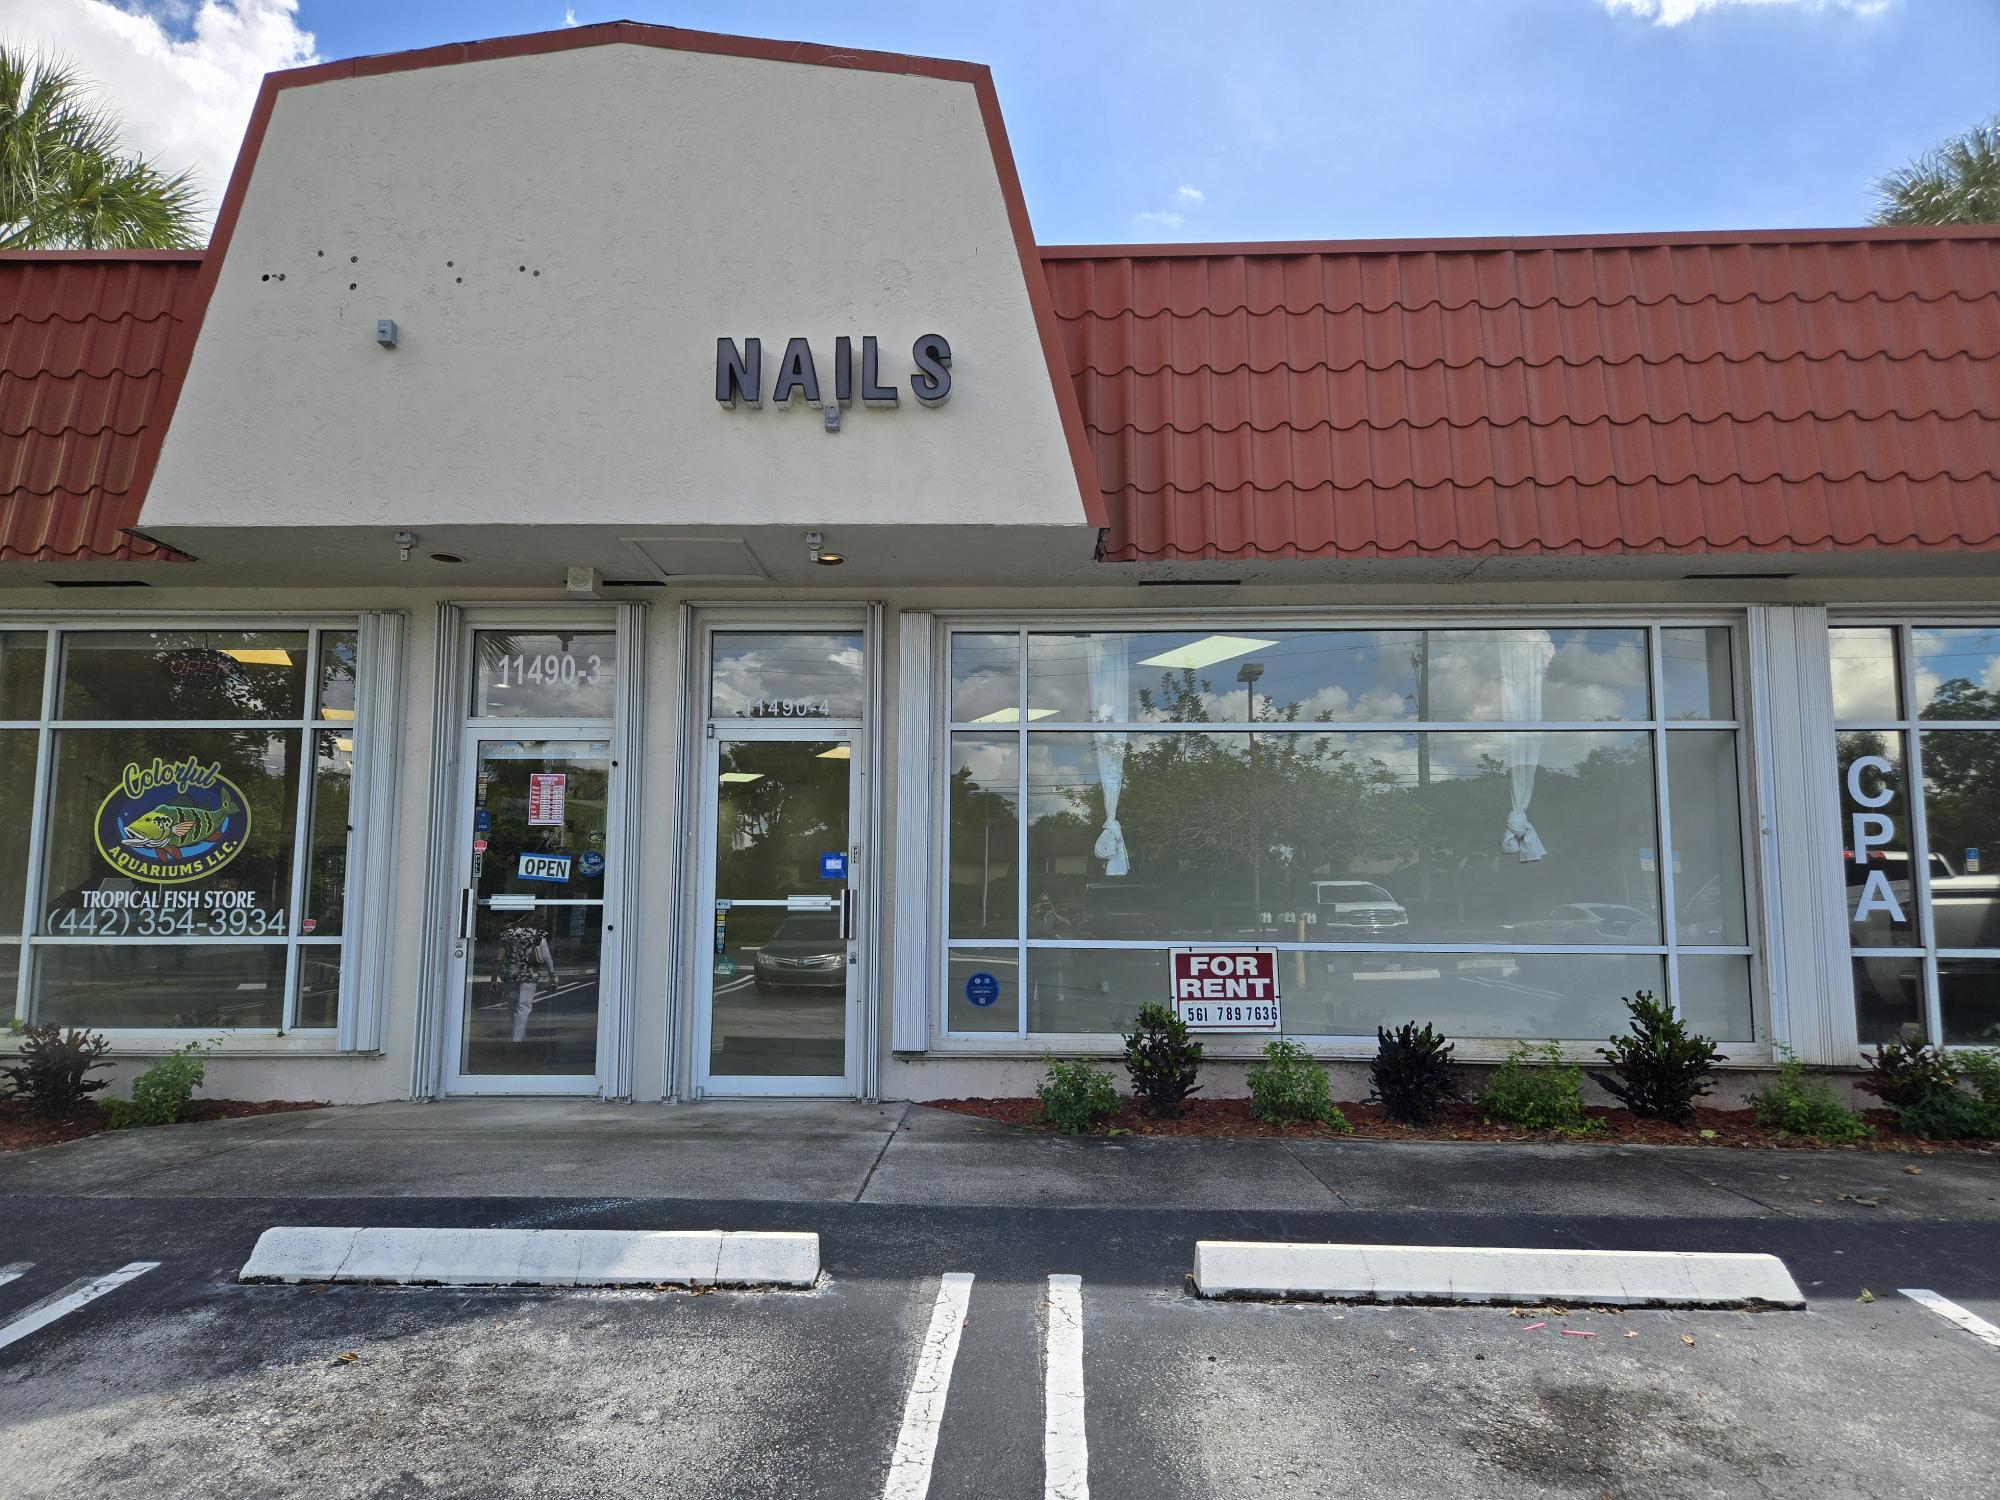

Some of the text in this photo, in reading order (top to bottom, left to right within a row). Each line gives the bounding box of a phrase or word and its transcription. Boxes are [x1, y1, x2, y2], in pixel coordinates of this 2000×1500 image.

[715, 334, 953, 405] NAILS
[498, 654, 601, 685] 11490-3
[744, 698, 830, 717] 11490-4
[123, 756, 221, 799] Colorful
[109, 845, 204, 877] AQUARIUMS
[524, 858, 567, 878] OPEN
[82, 890, 255, 908] TROPICAL FISH STORE
[47, 908, 130, 936] (442)
[137, 908, 287, 936] 354-3934
[1190, 956, 1258, 976] FOR
[1179, 978, 1270, 998] RENT
[1188, 1006, 1278, 1022] 561 789 7636
